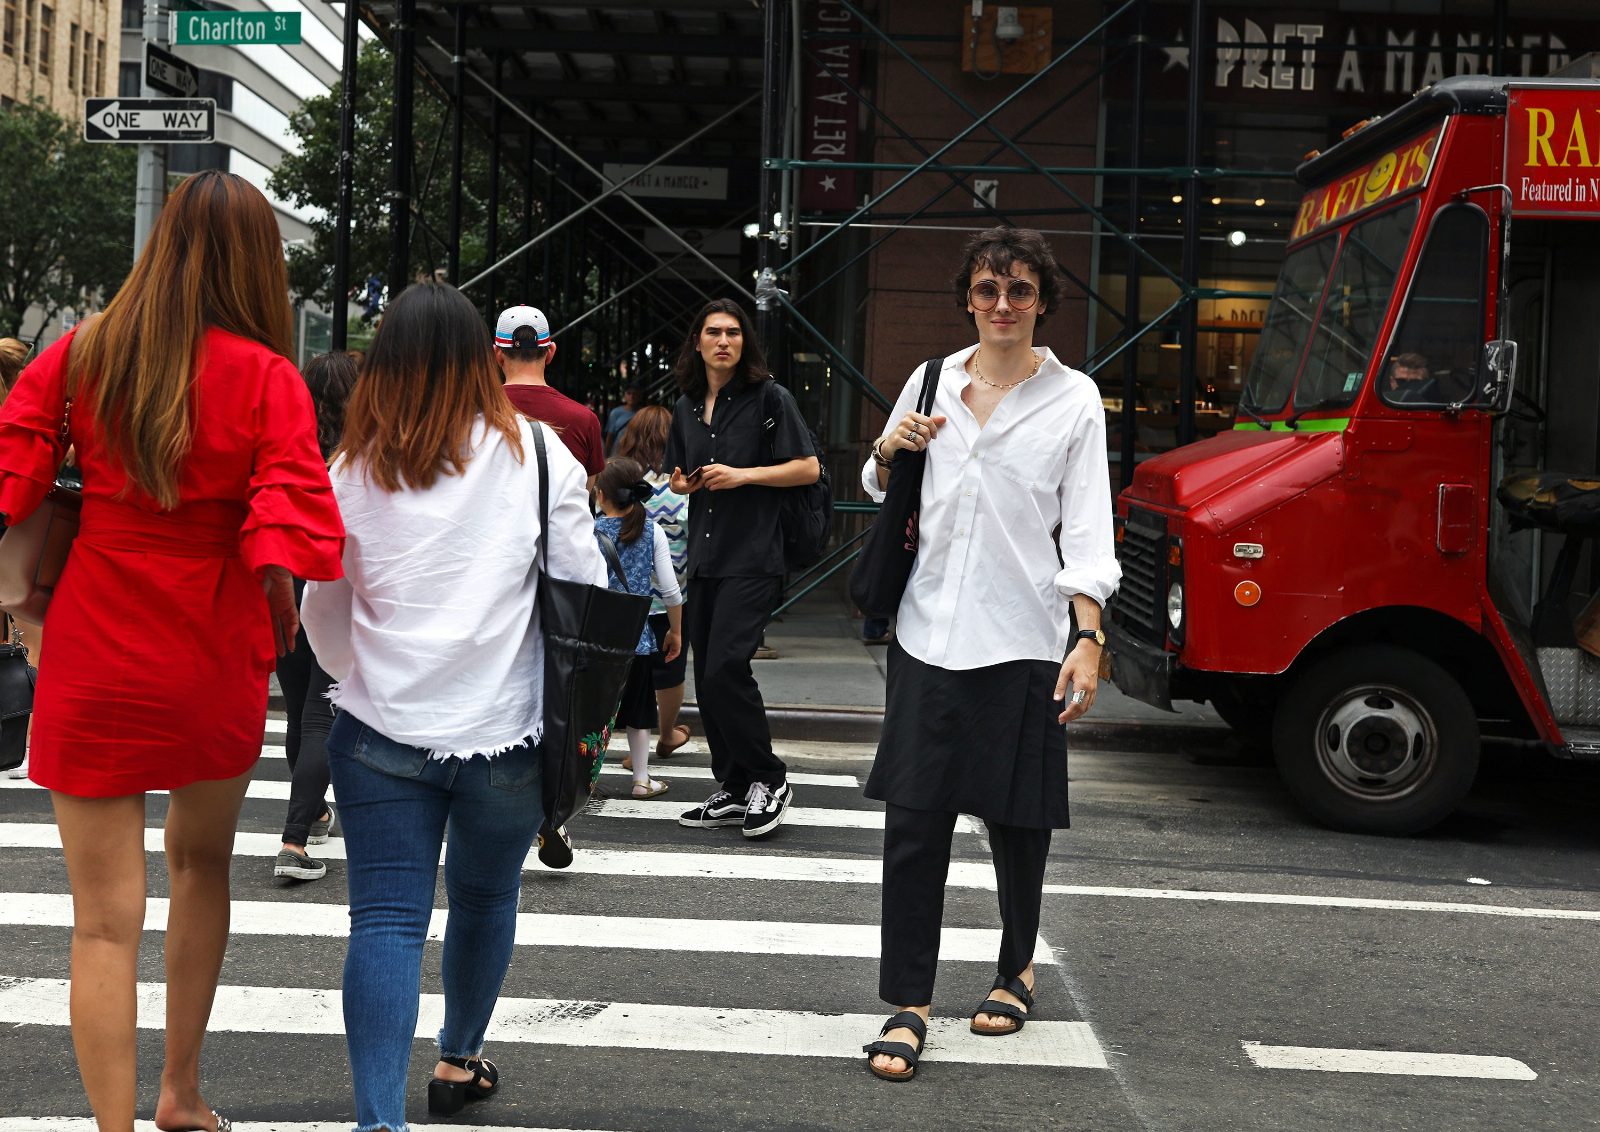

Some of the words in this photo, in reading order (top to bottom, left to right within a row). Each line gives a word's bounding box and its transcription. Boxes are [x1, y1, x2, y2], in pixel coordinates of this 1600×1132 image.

[189, 16, 266, 41] Charlton
[275, 16, 287, 31] St
[1215, 17, 1324, 91] PRET
[1336, 27, 1365, 93] A
[151, 58, 168, 81] ONE
[175, 70, 193, 92] WAY
[102, 112, 141, 128] ONE
[163, 112, 203, 128] WAY
[811, 115, 848, 166] RET
[1524, 107, 1600, 168] RA
[655, 176, 662, 188] A
[1520, 177, 1572, 202] Featured
[1575, 178, 1586, 202] in
